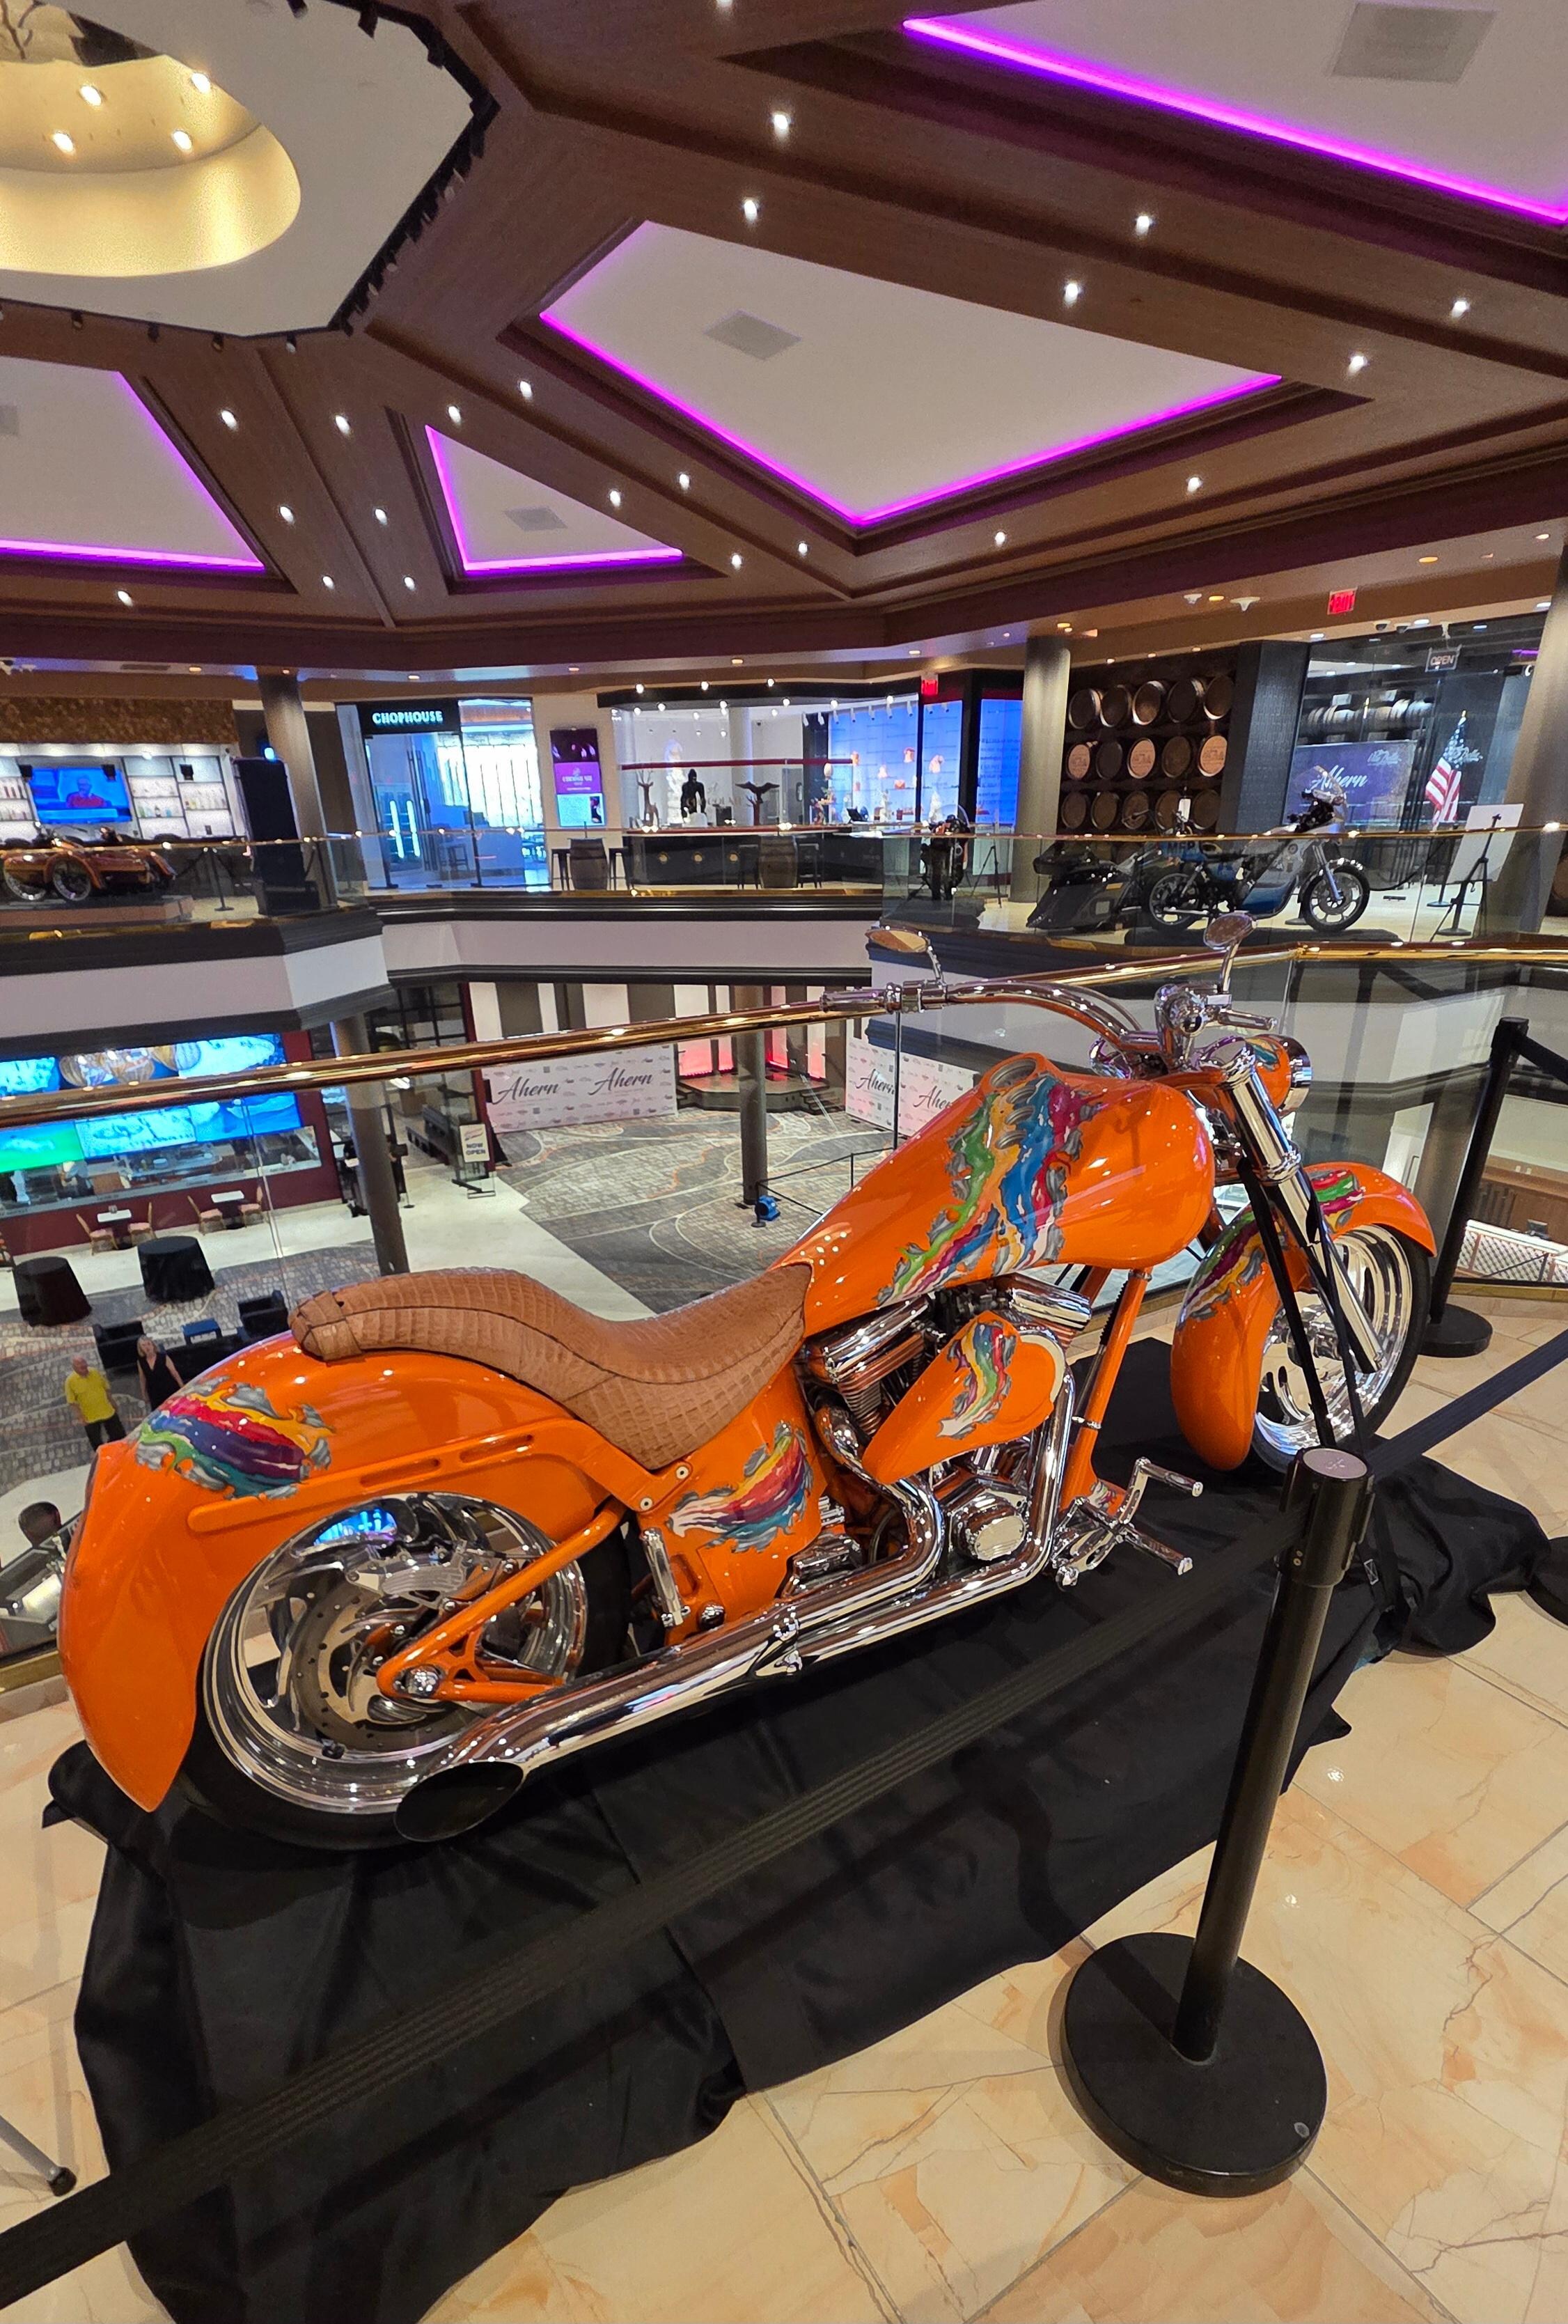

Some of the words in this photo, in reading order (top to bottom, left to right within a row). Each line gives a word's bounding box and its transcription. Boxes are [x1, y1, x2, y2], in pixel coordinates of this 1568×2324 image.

[1430, 655, 1455, 666] OPEN
[372, 710, 444, 725] CHOPHOUSE
[1310, 765, 1368, 790] Ahern
[492, 1076, 559, 1105] Ahern
[588, 1067, 652, 1095] Ahern
[913, 1085, 951, 1109] Aher
